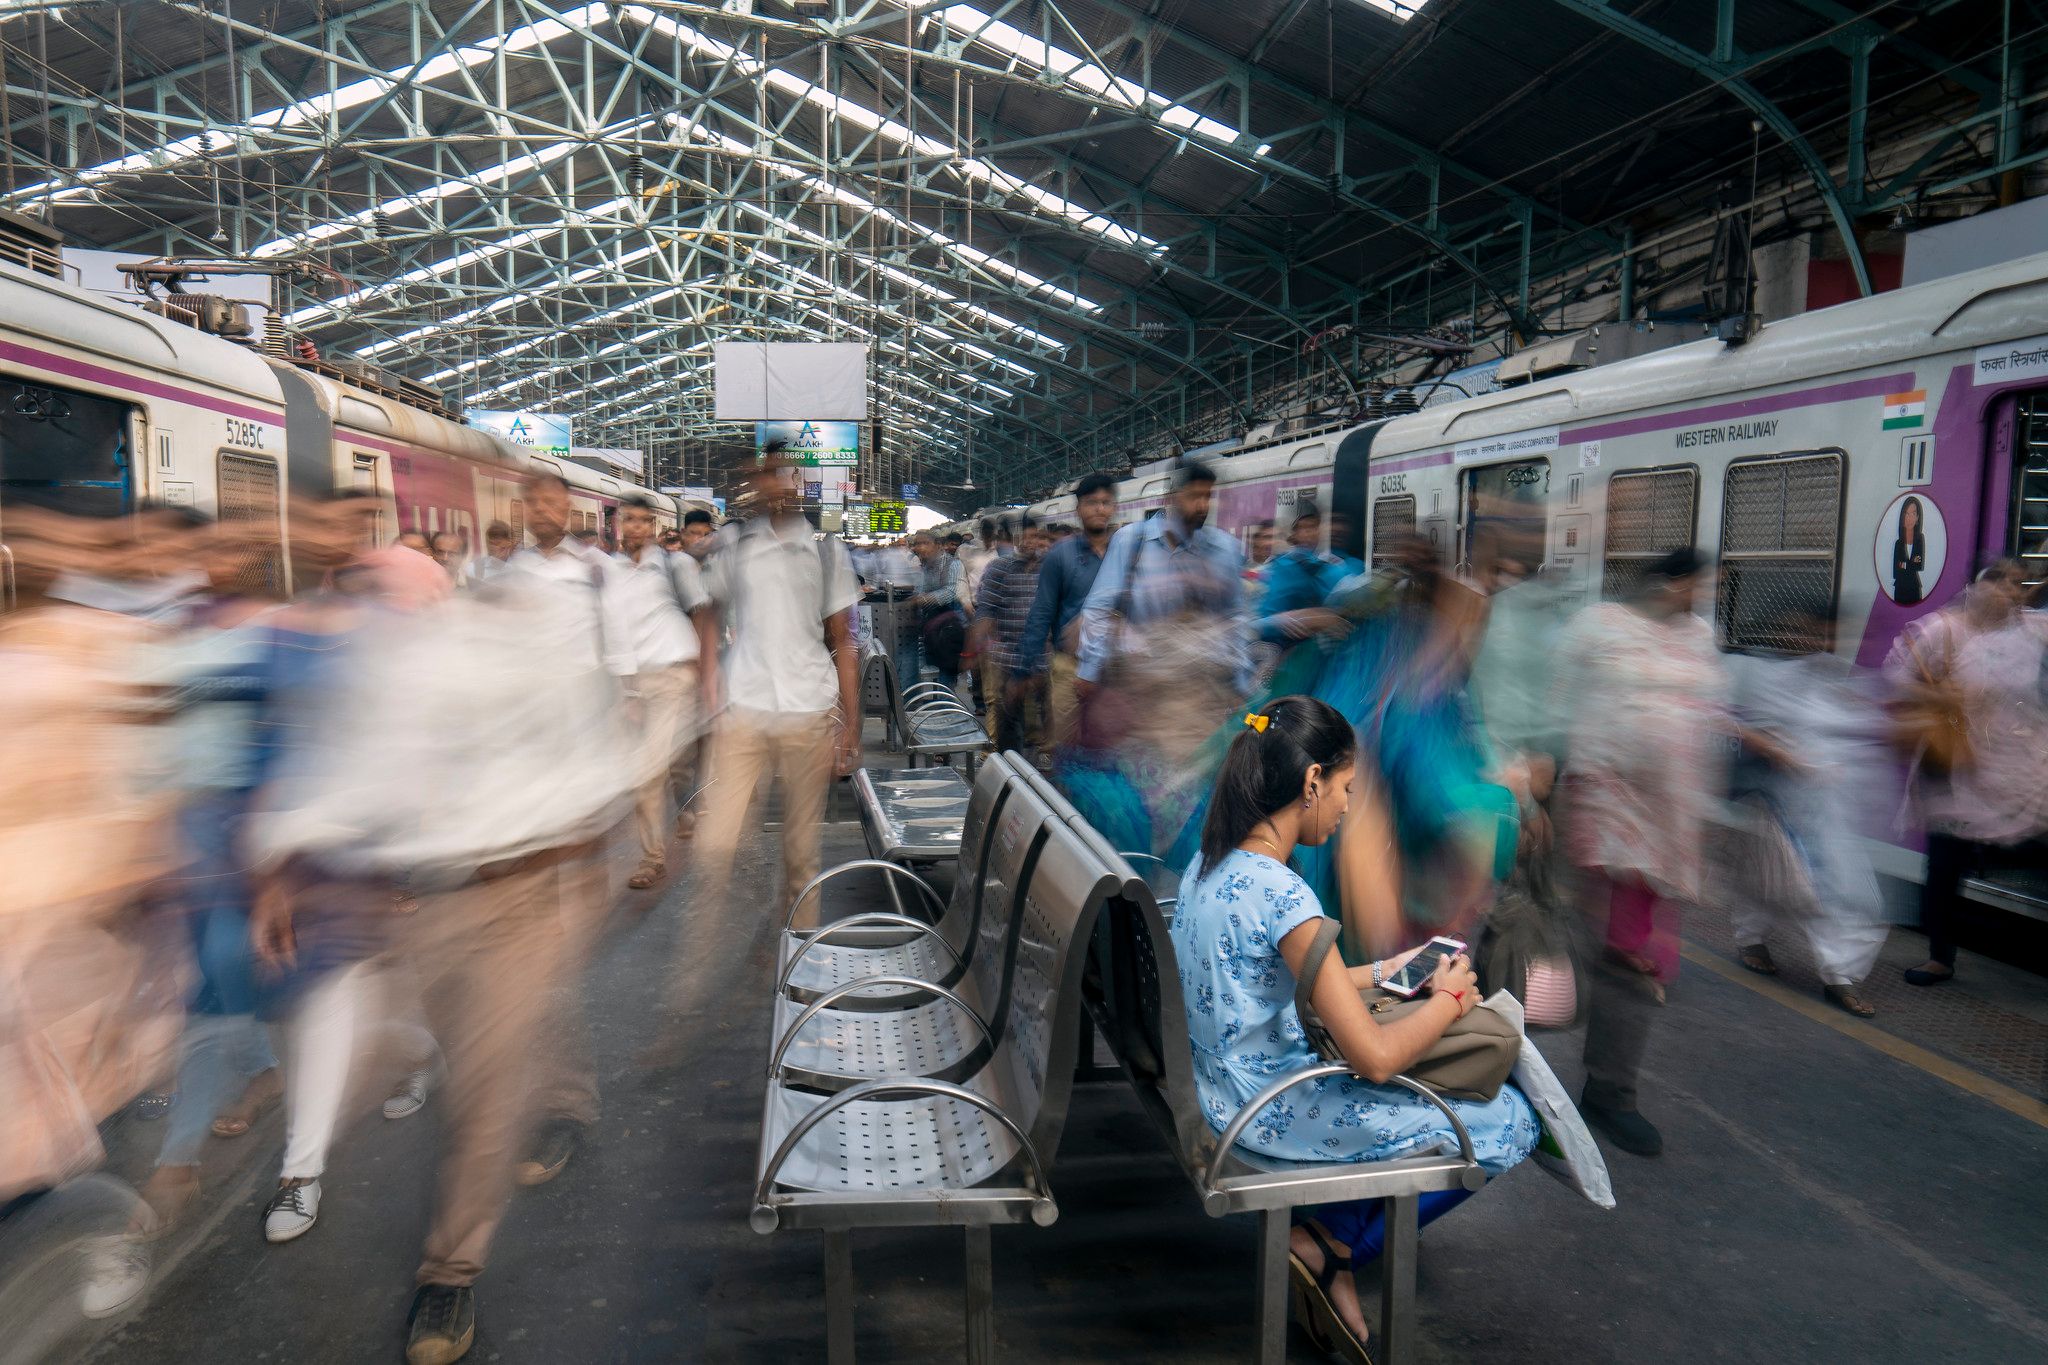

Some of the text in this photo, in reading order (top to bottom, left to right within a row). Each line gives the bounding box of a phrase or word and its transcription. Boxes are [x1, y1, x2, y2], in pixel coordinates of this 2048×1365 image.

[1981, 357, 2007, 372] फक्त
[226, 418, 264, 449] 5285C
[1527, 434, 1558, 447] COMPARTMENT
[1676, 419, 1779, 448] WESTERN RAILWAY
[1382, 474, 1406, 494] 6033C
